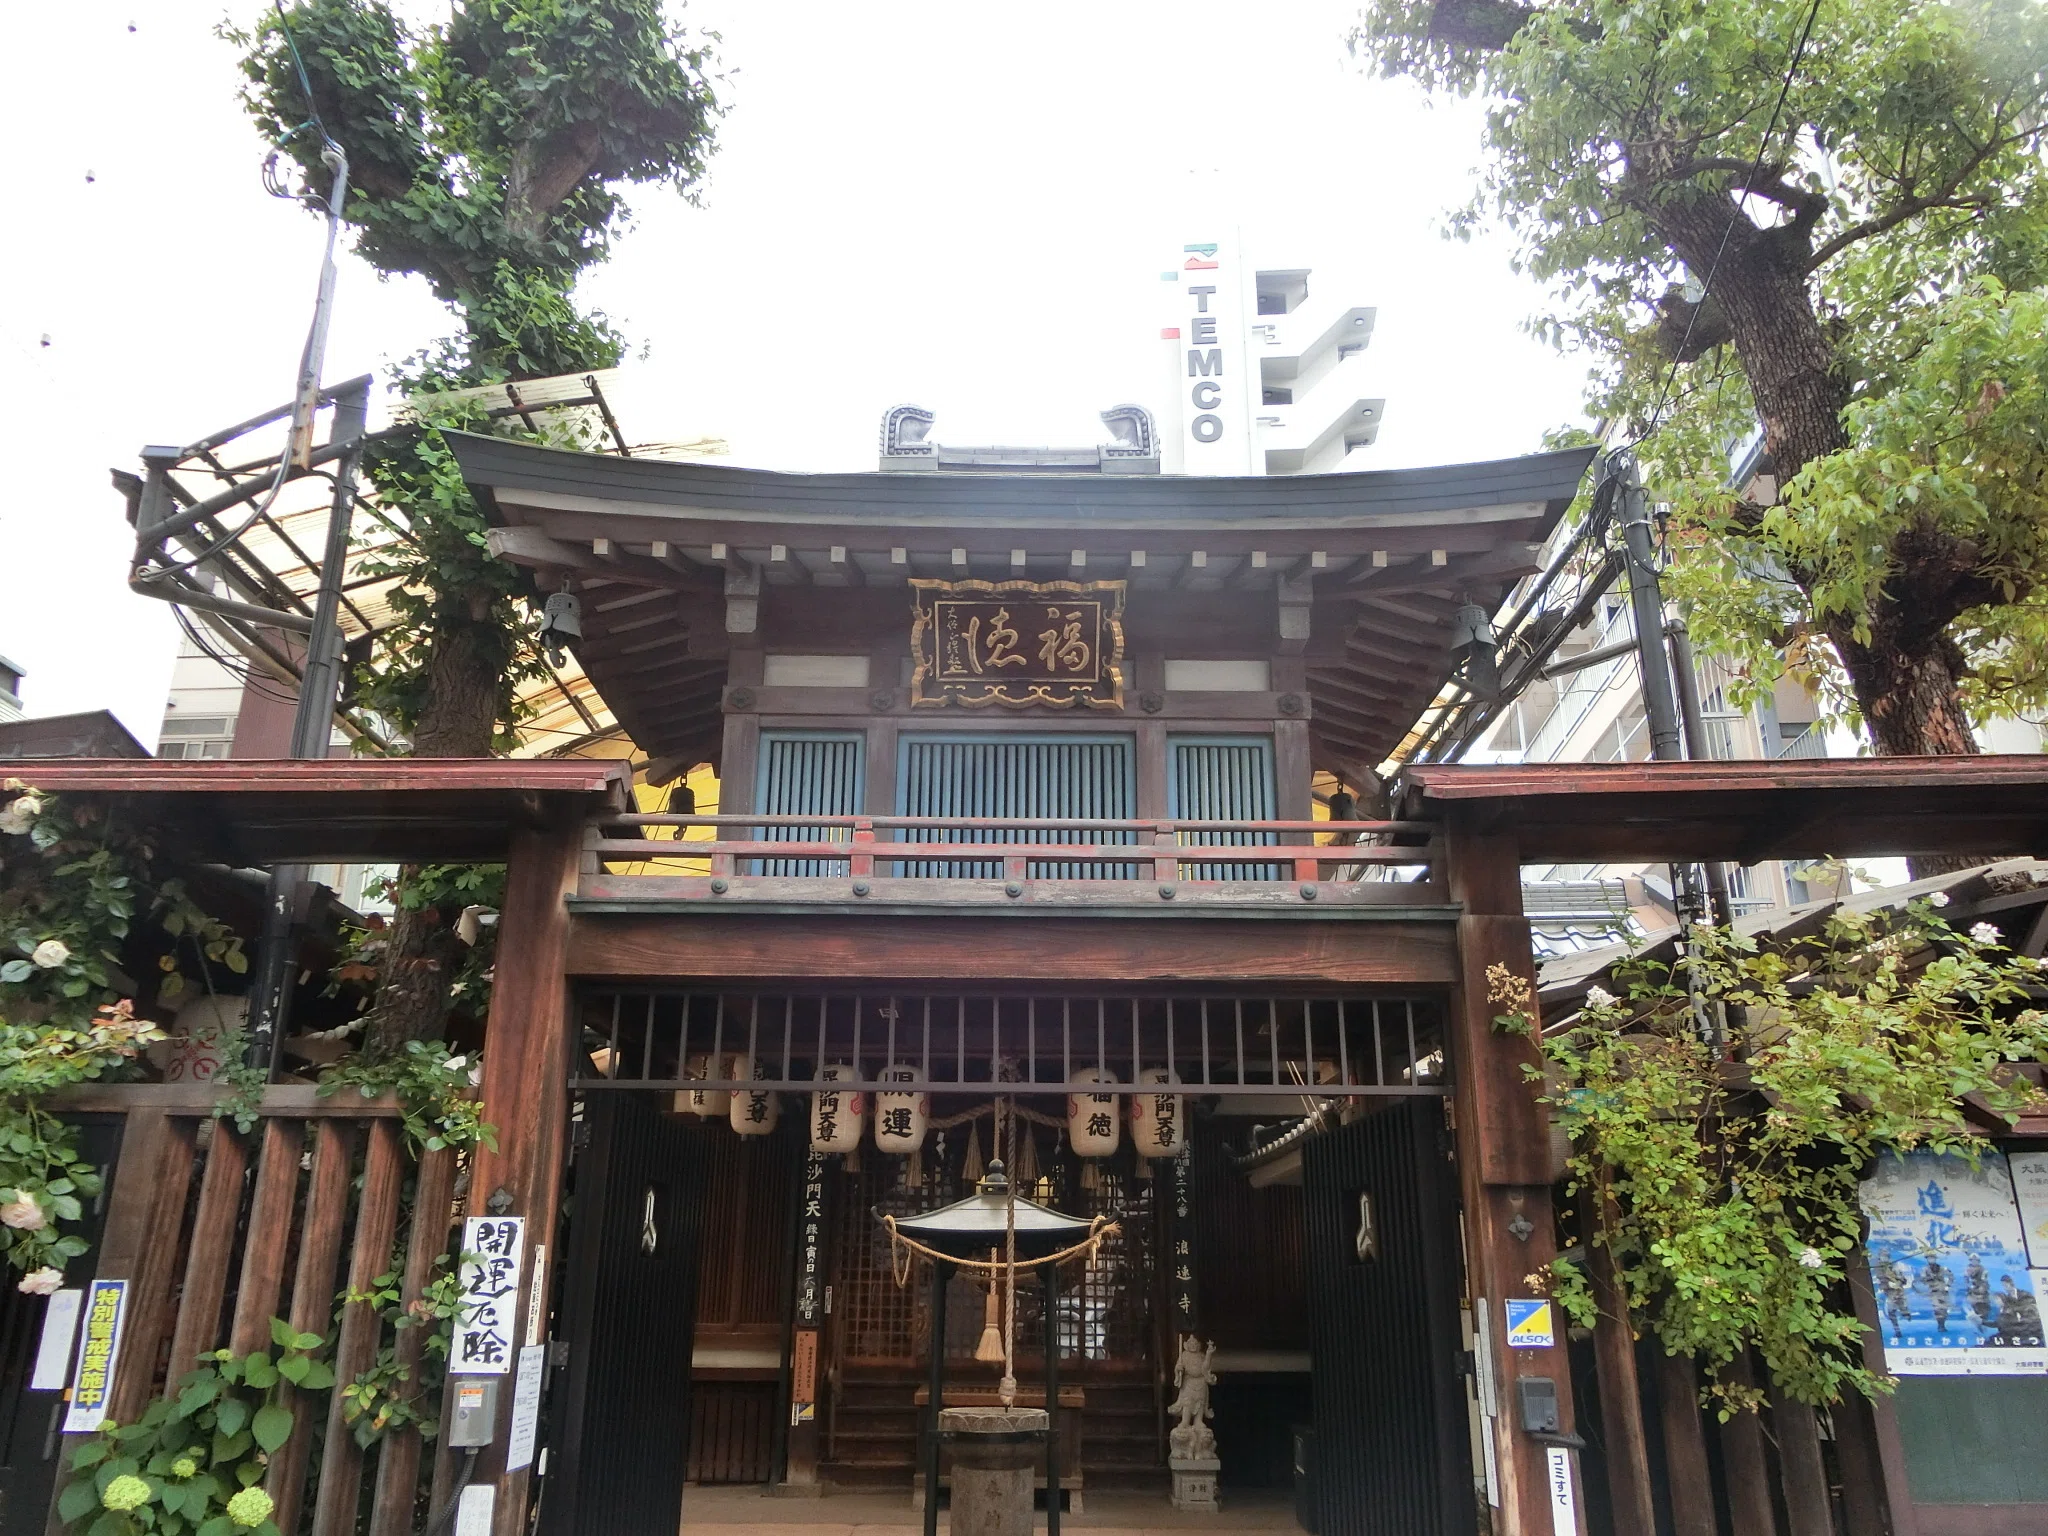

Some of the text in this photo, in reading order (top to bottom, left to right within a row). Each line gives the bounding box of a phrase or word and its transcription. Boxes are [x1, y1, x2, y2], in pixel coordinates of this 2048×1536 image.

[1187, 285, 1223, 443] TEMCO
[77, 1288, 121, 1406] 特別警戒実施中
[461, 1221, 518, 1364] 開運厄除
[1511, 1335, 1551, 1344] ALSOK
[1889, 1336, 2039, 1346] おおさかのけいさつ
